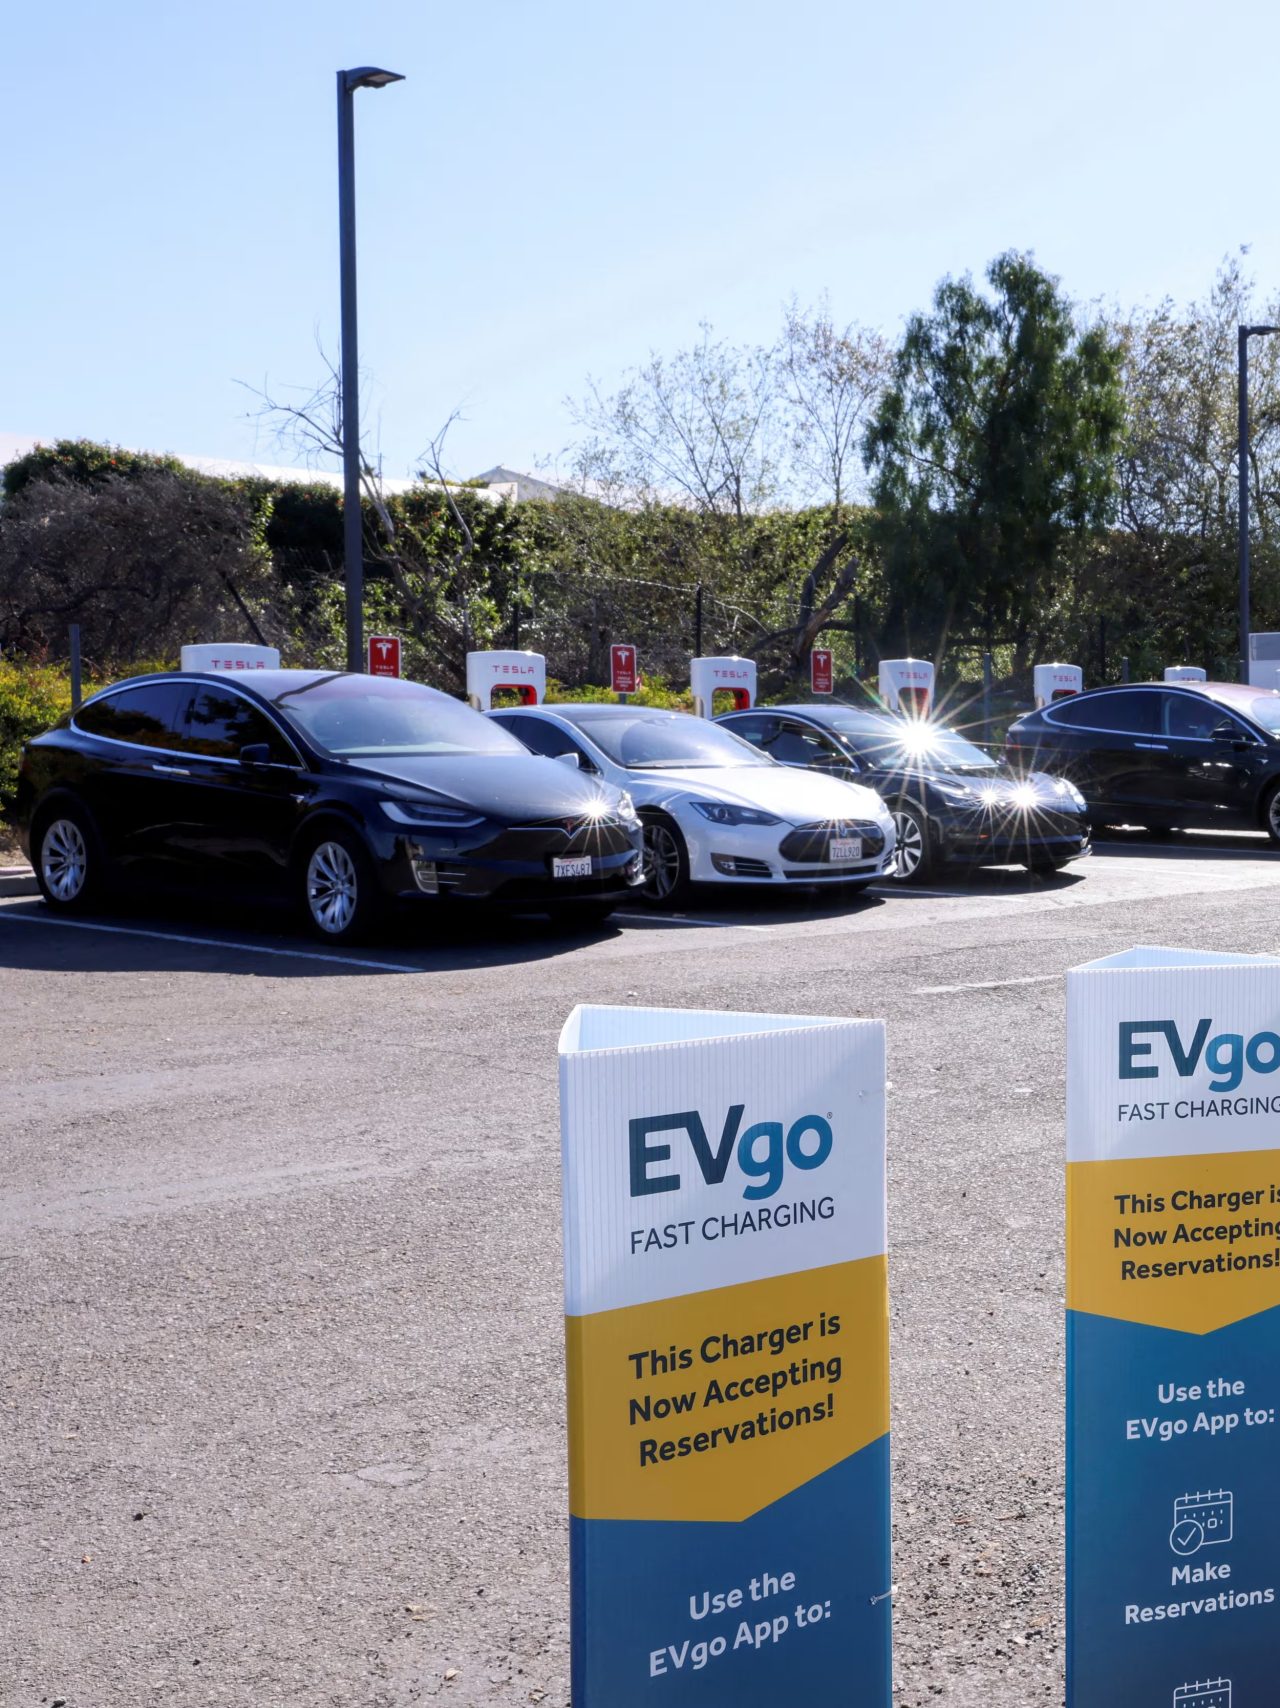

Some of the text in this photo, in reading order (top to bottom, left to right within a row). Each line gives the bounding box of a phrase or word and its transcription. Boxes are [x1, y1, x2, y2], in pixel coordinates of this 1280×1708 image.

[211, 660, 264, 669] TESLA
[492, 665, 534, 674] TESLA
[713, 670, 748, 678] TESLA
[1118, 1102, 1169, 1121] FAST
[1114, 1193, 1164, 1214] This
[1171, 1186, 1264, 1212] Charger
[630, 1197, 835, 1254] FAST CHARGING
[1113, 1228, 1167, 1248] Now
[1121, 1248, 1280, 1280] Reservations!
[628, 1312, 841, 1380] This Charger is
[628, 1356, 842, 1425] Now Accepting
[1157, 1377, 1245, 1404] Use the
[640, 1393, 834, 1466] Reservations!
[1126, 1407, 1275, 1441] EVgo App to:
[1171, 1562, 1231, 1586] Make
[689, 1571, 796, 1621] Use the
[1125, 1586, 1275, 1625] Reservations
[649, 1600, 831, 1677] EVgo App to:
